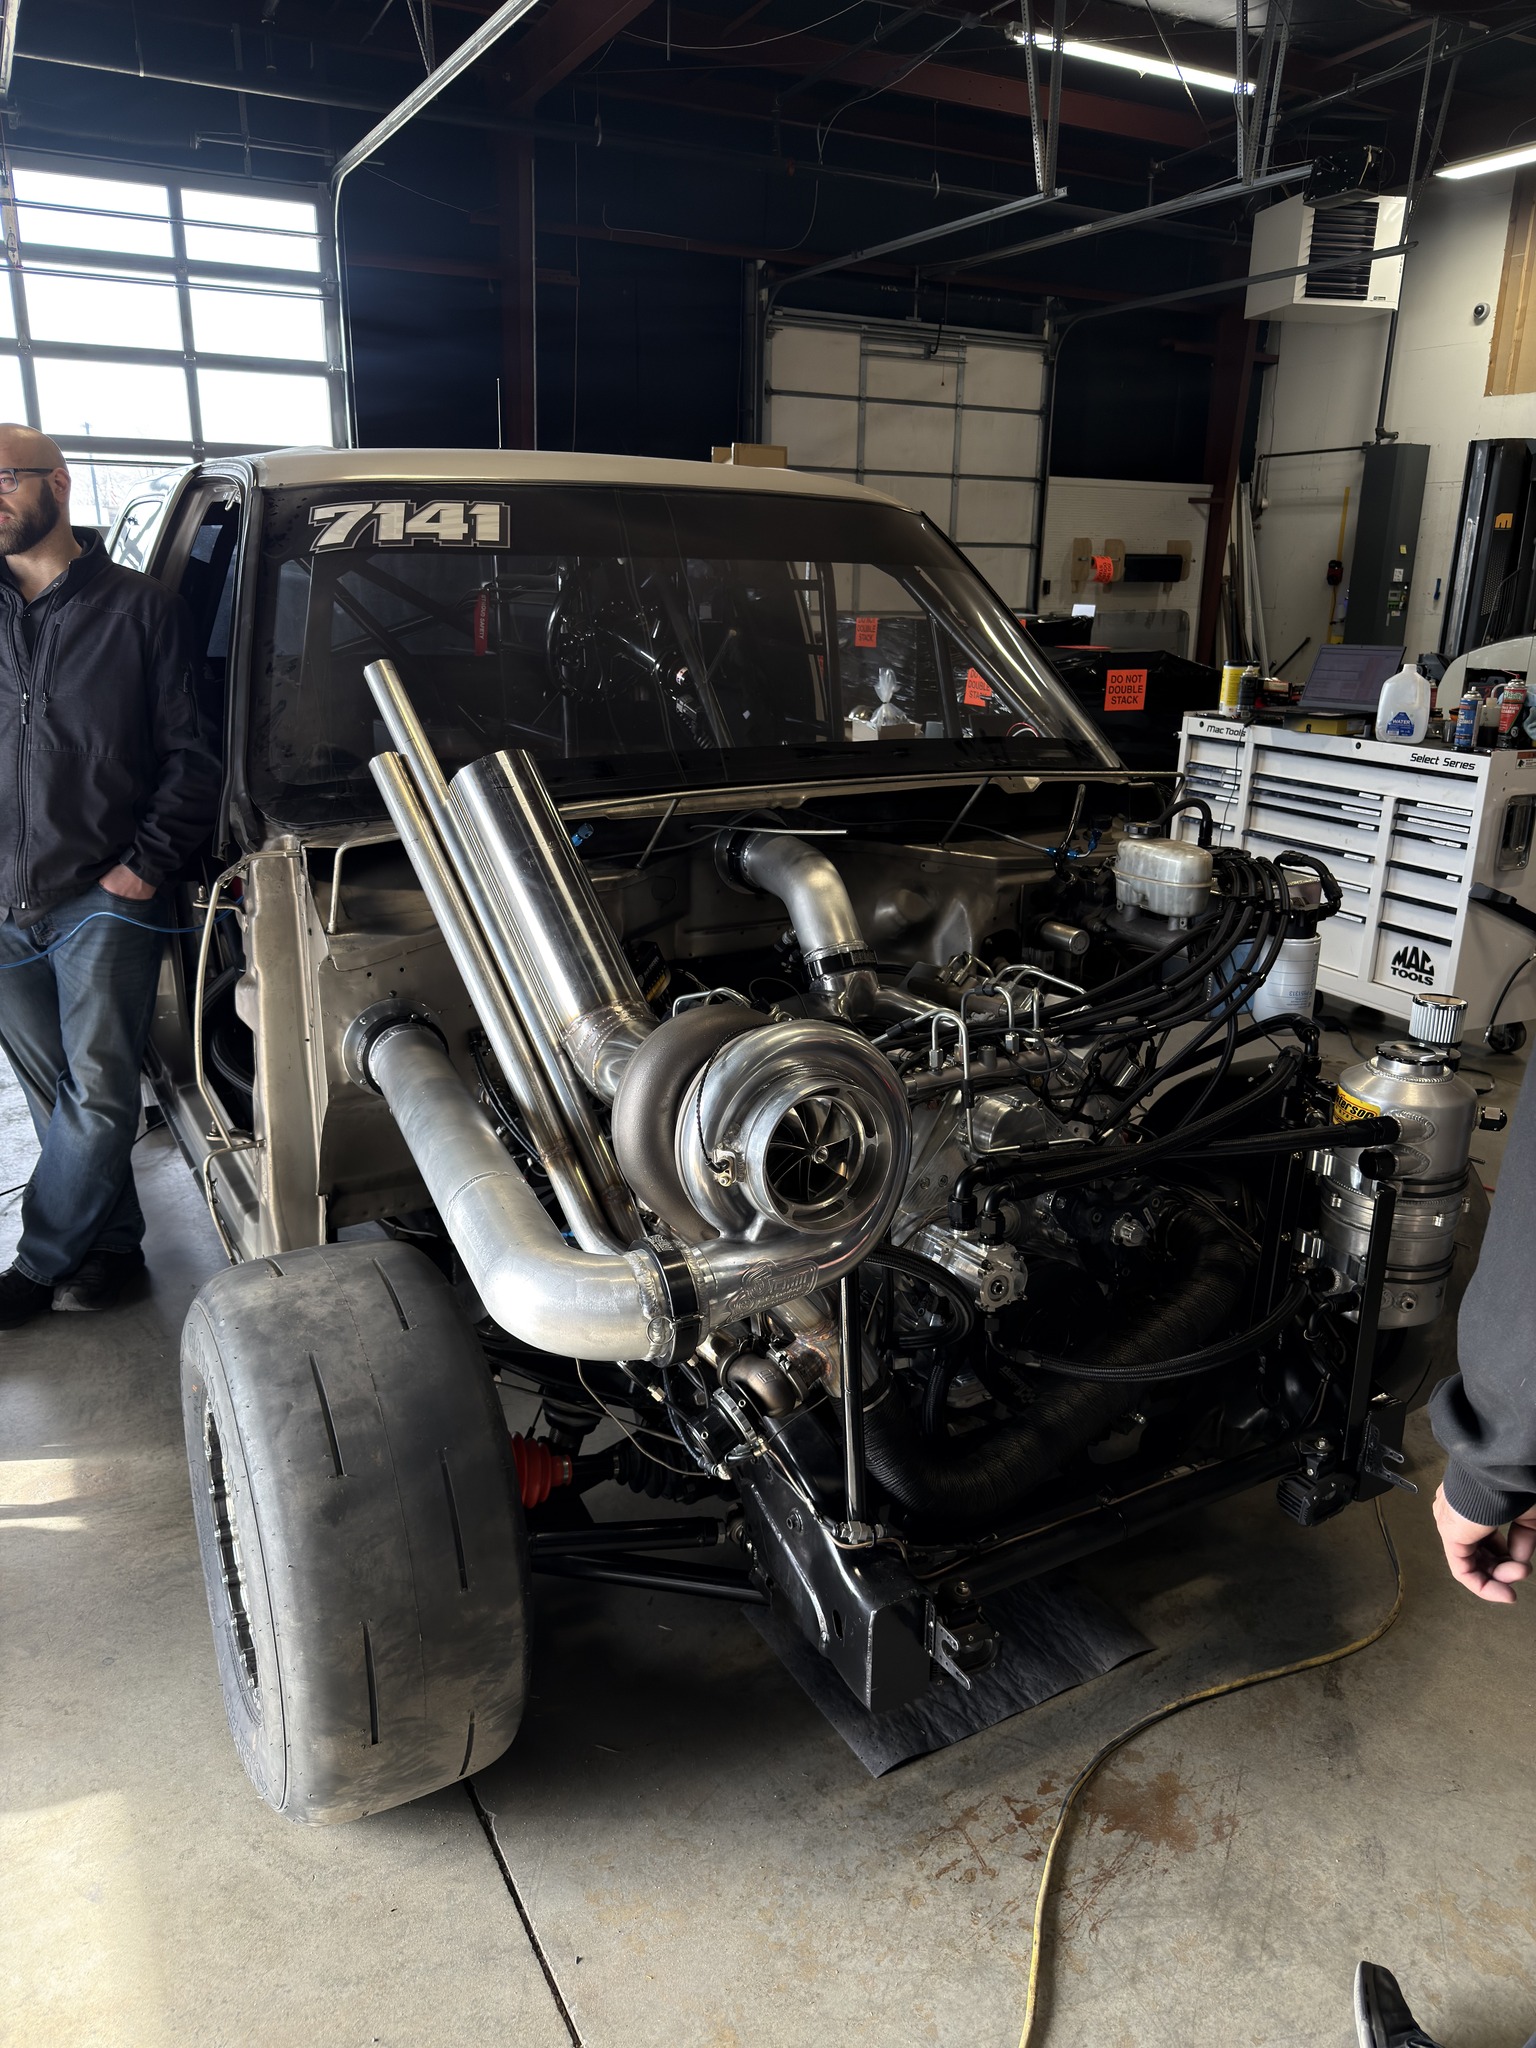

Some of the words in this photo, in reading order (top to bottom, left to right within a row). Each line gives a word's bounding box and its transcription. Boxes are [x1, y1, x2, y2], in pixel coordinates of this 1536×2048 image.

[308, 500, 510, 553] 7141
[857, 624, 876, 633] DOUBLE
[858, 633, 873, 641] STACK
[1111, 675, 1123, 684] DO
[1126, 675, 1142, 683] NOT
[1108, 685, 1143, 694] DOUBLE
[1111, 696, 1139, 704] STACK
[1206, 725, 1224, 734] Mac
[1225, 727, 1247, 737] Tools
[1410, 753, 1439, 765] Select
[1442, 757, 1476, 770] Series
[1391, 946, 1434, 977] MAC
[1391, 966, 1434, 986] TOOLS
